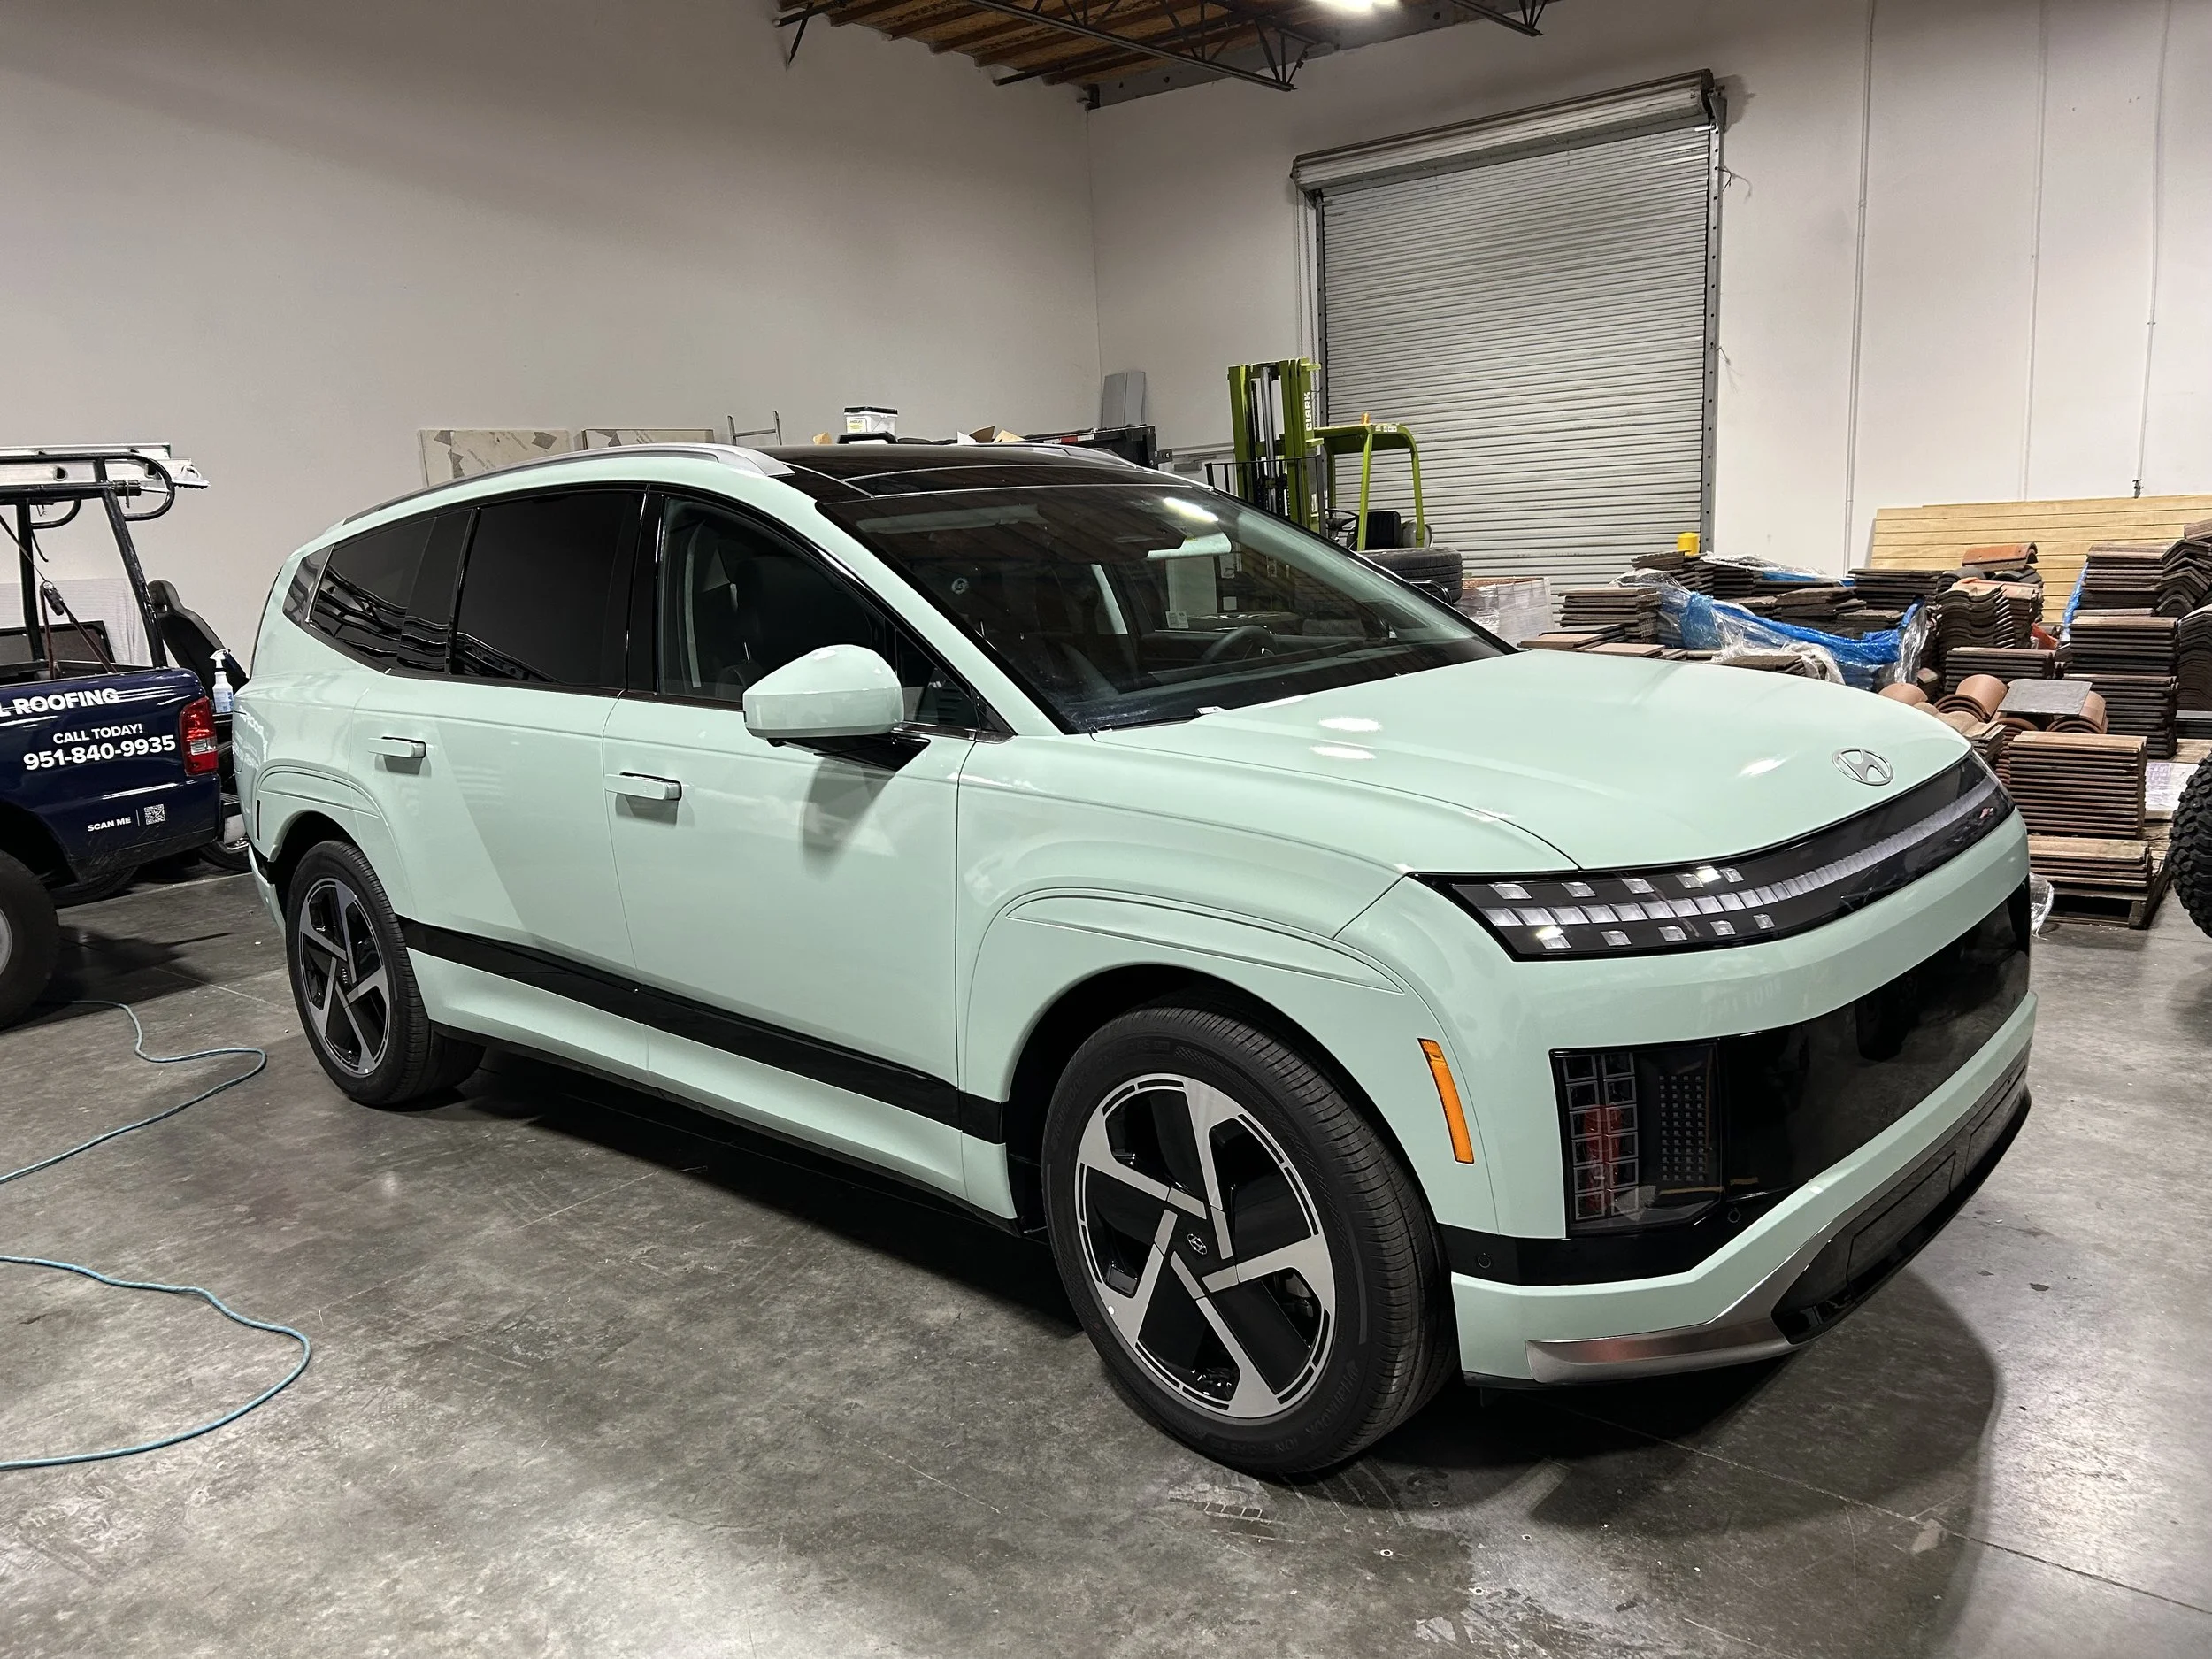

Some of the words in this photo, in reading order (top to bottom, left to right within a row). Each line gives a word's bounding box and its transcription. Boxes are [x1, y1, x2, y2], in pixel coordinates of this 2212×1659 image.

[1303, 391, 1313, 432] CLARK
[12, 689, 120, 715] ROOFING
[53, 731, 90, 745] CALL
[91, 723, 144, 740] TODAY!
[23, 734, 176, 771] 951-840-9935
[87, 820, 115, 832] SCAN
[116, 817, 132, 826] ME
